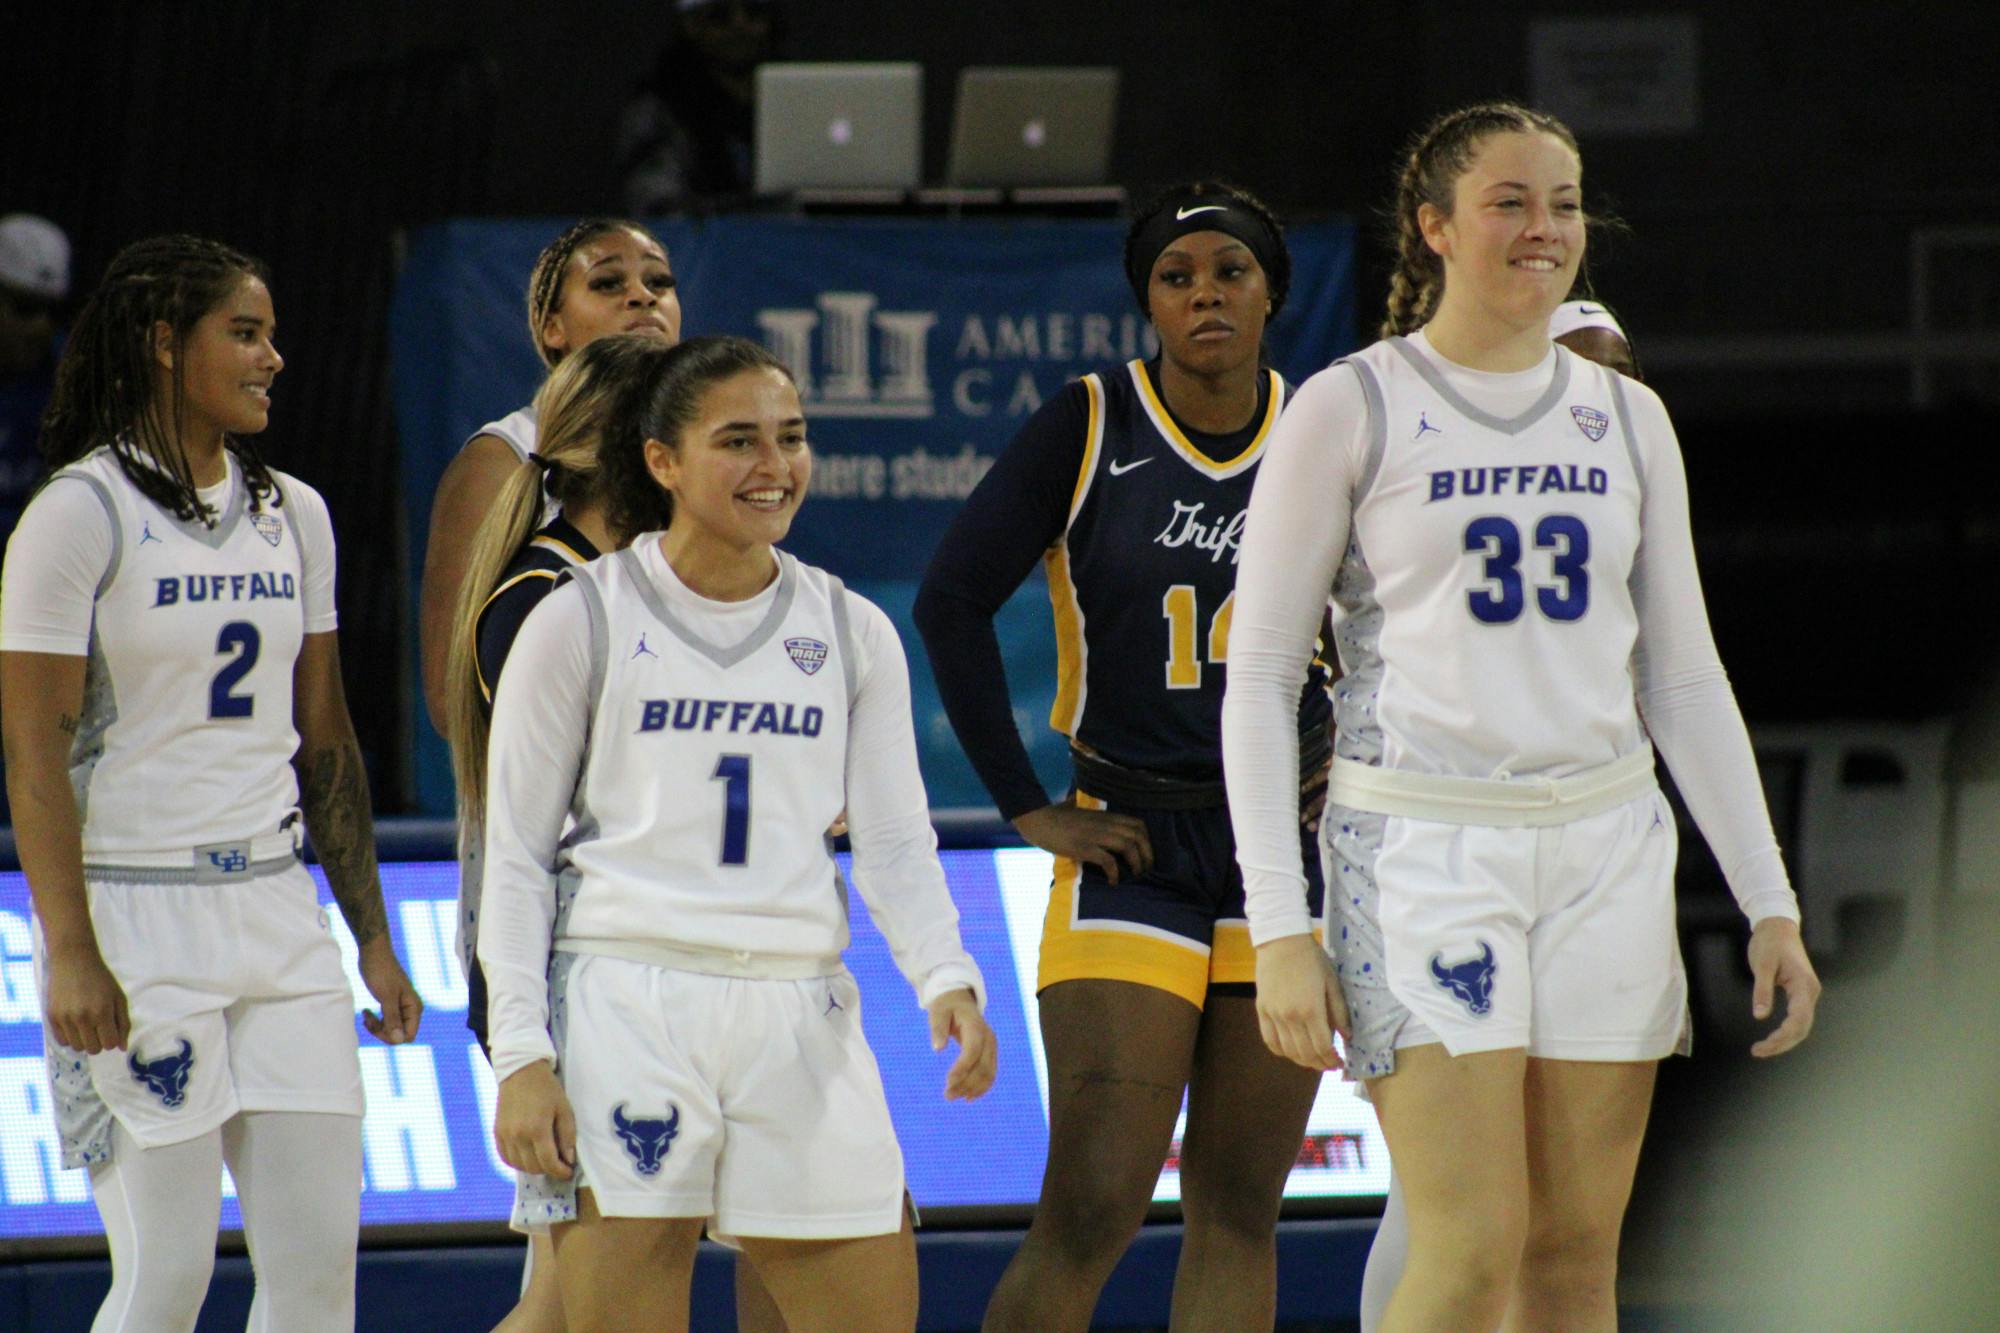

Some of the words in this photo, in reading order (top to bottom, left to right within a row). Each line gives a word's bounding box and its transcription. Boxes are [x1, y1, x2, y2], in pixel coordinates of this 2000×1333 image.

[953, 367, 1078, 417] CA
[808, 445, 886, 498] here
[1425, 464, 1608, 504] BUFFALO
[150, 571, 295, 608] BUFFALO
[1462, 512, 1592, 627] 33
[208, 619, 261, 720] 2
[789, 648, 826, 661] MAC
[635, 698, 824, 738] BUFFALO
[710, 752, 752, 867] 1
